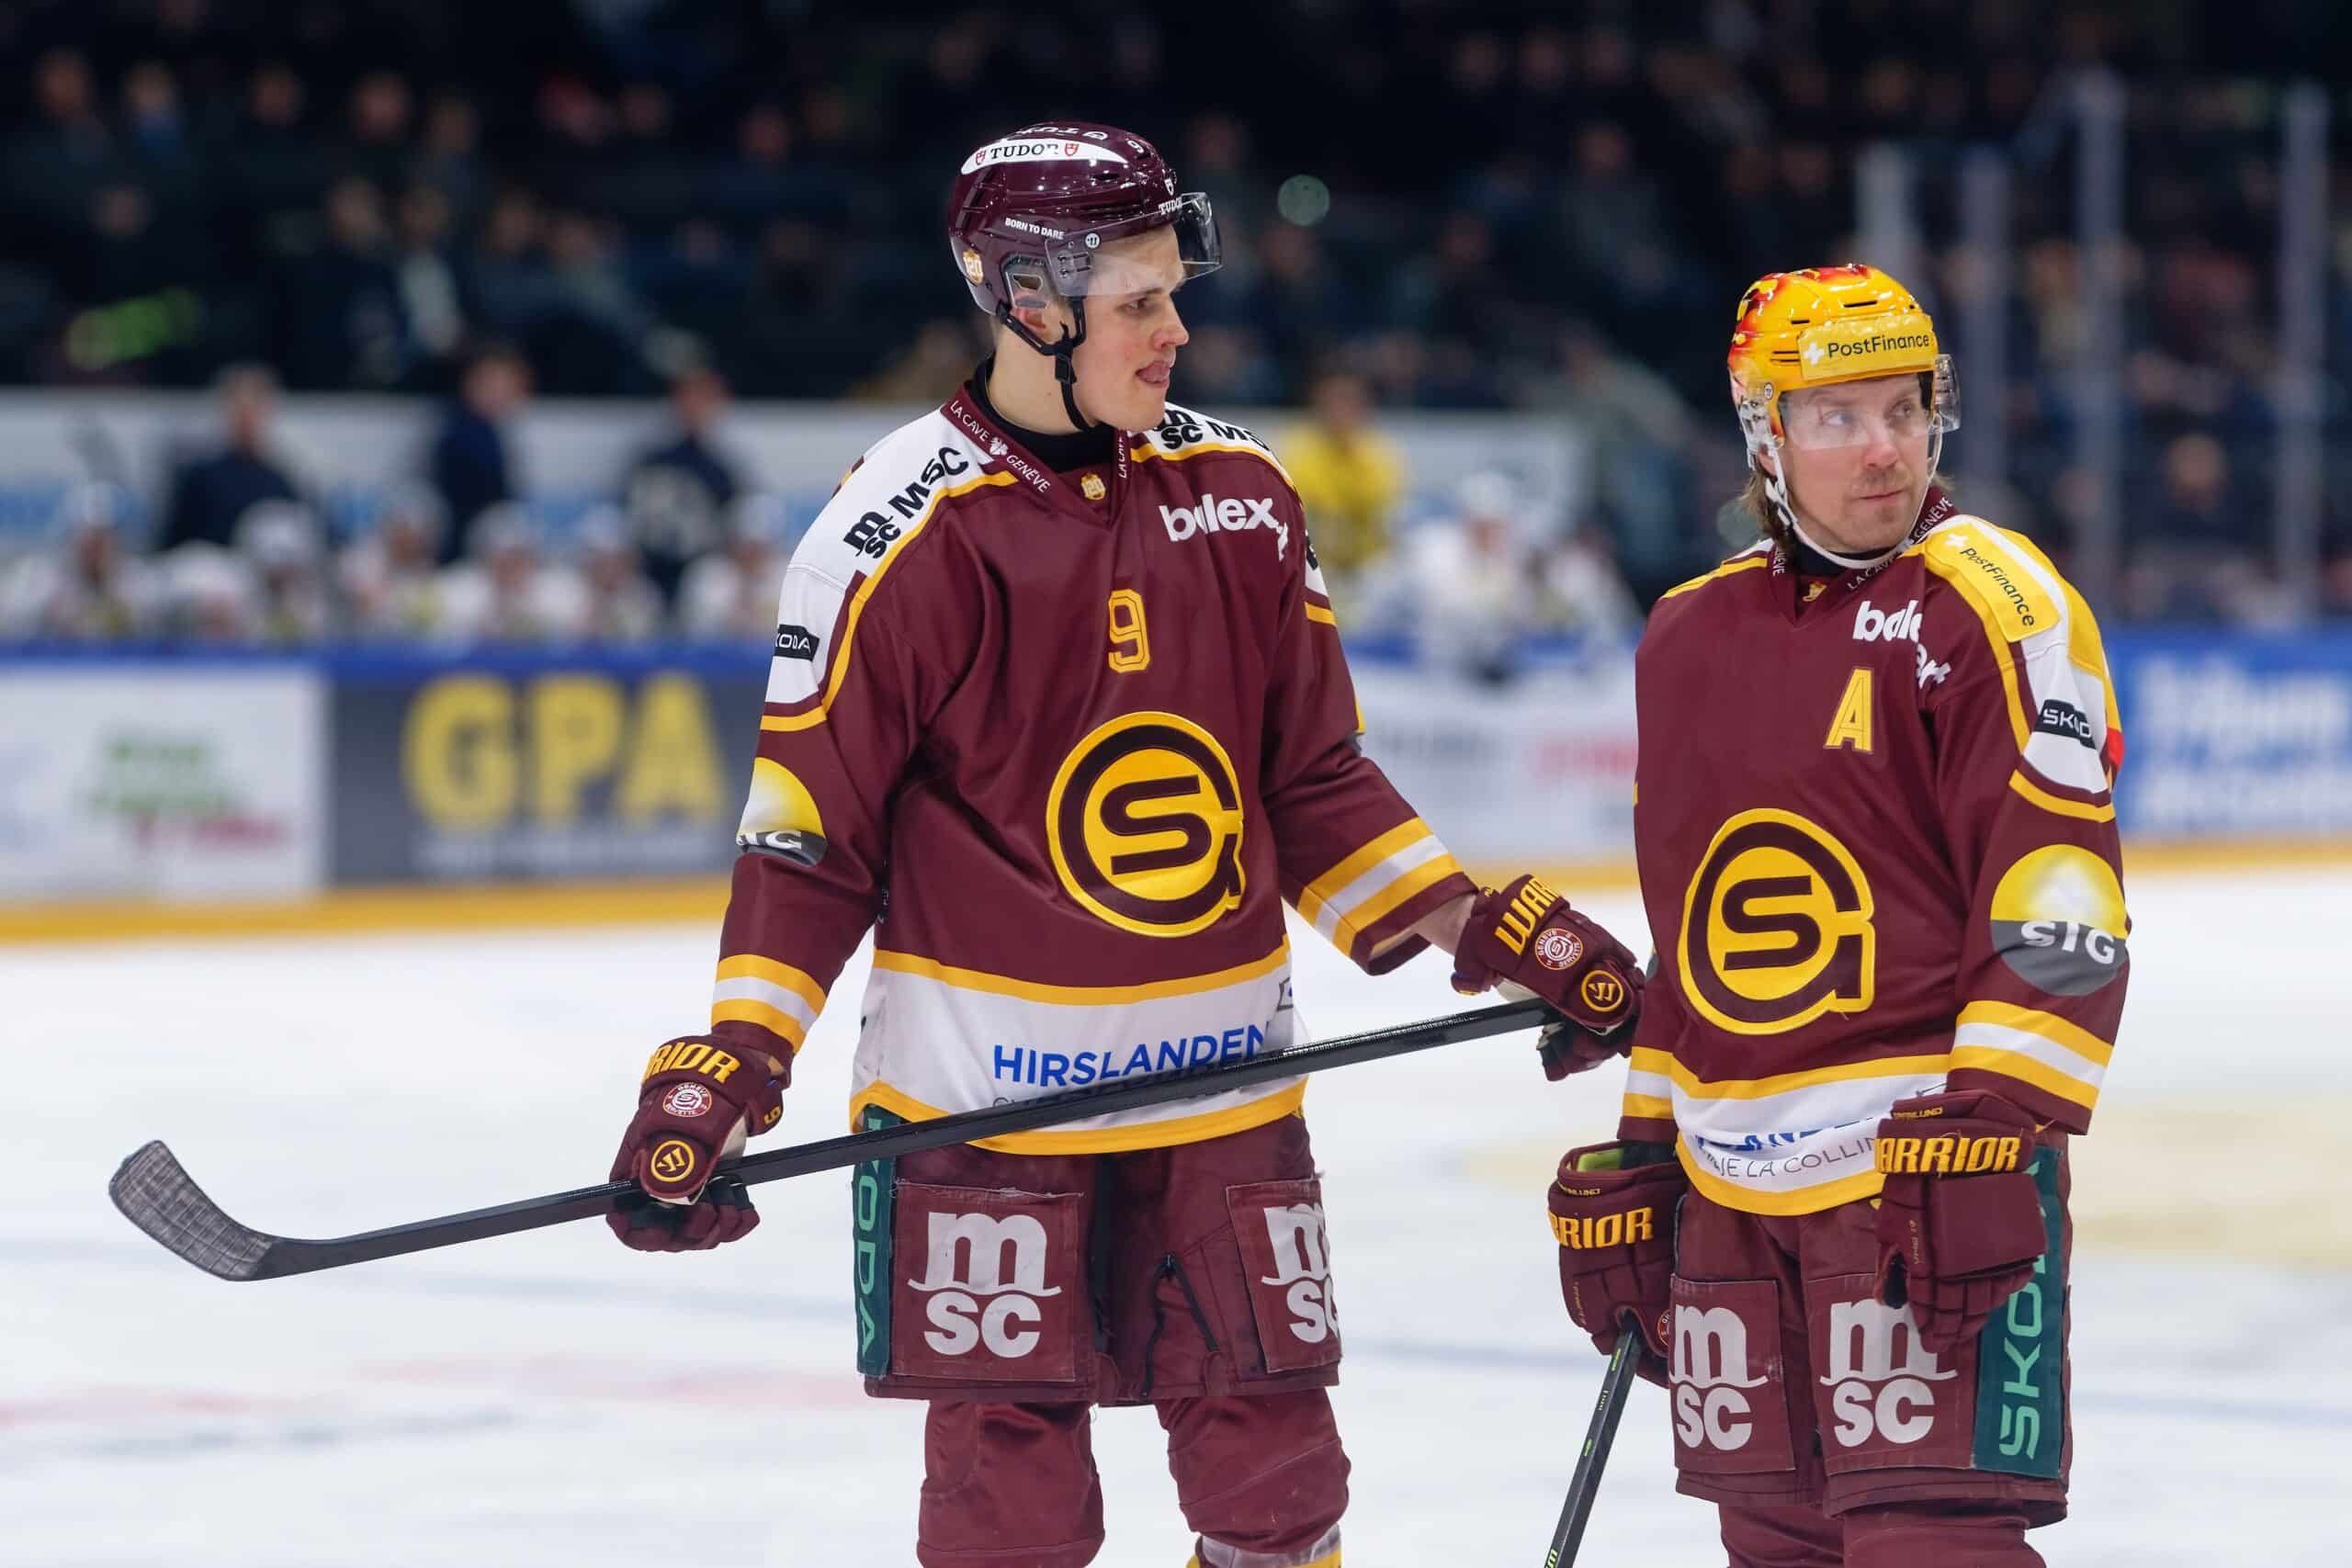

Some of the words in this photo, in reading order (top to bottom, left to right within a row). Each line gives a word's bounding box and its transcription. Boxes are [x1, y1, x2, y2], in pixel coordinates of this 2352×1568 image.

[1005, 218, 1027, 231] BORN
[1029, 224, 1040, 233] TO
[1041, 228, 1065, 240] DARE
[1827, 333, 1930, 358] PostFinance
[950, 400, 963, 418] LA
[962, 413, 989, 442] CAVE
[888, 446, 969, 519] MSC
[1847, 575, 1865, 590] LA
[1960, 547, 2035, 627] PostFinance
[775, 633, 812, 654] ODA
[1108, 589, 1150, 673] 9
[1825, 668, 1873, 752] A
[402, 673, 722, 830] GPA
[2020, 919, 2116, 965] SIG
[645, 1042, 742, 1084] RIOR
[993, 1023, 1266, 1088] HIRSLANDEN
[1747, 1158, 1776, 1178] LA
[1874, 1137, 2021, 1175] ARRIOR
[1998, 1255, 2045, 1461] SKO
